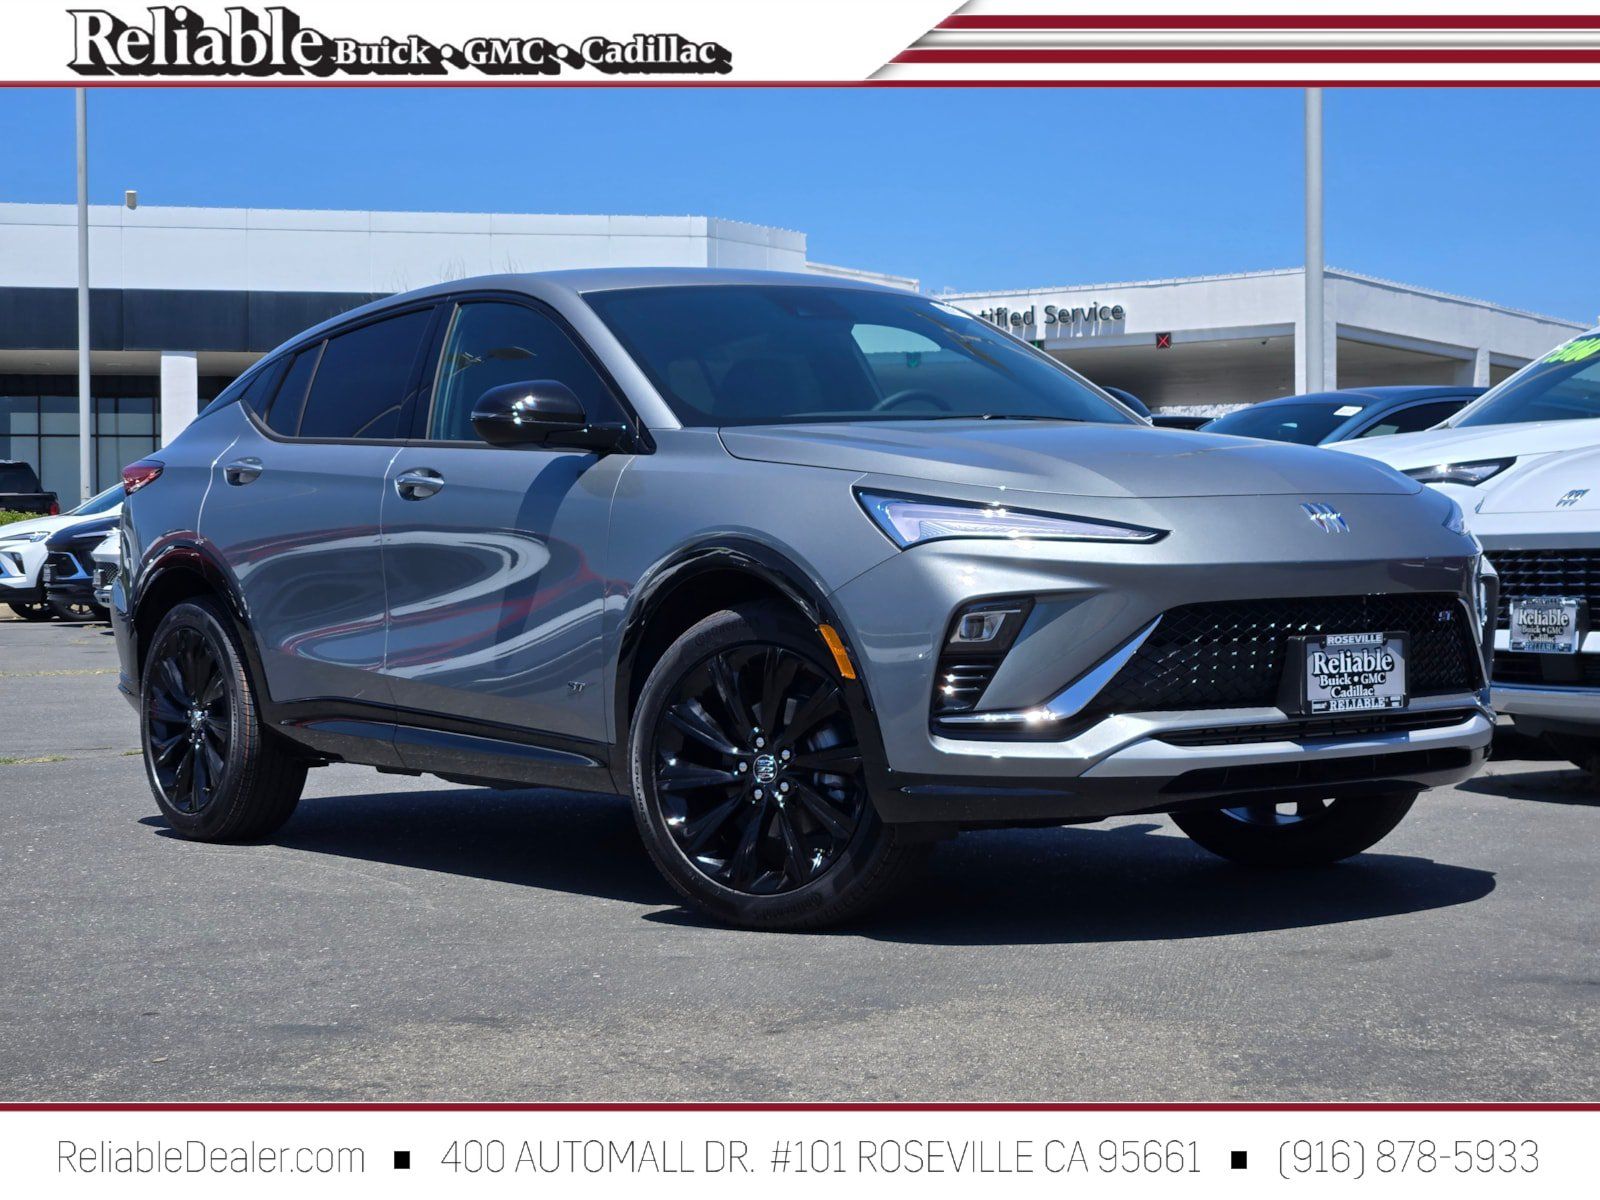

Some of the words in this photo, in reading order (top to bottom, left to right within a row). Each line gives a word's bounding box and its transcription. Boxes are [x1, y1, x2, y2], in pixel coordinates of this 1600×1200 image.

[1044, 301, 1124, 325] Service
[1518, 609, 1569, 627] Reliable
[1327, 633, 1383, 645] ROSEVILLE
[1312, 648, 1394, 676] Reliable
[1320, 674, 1352, 688] Buick
[1360, 672, 1387, 685] GMC
[1330, 685, 1375, 699] Cadillac
[1329, 696, 1386, 711] RELIABLE
